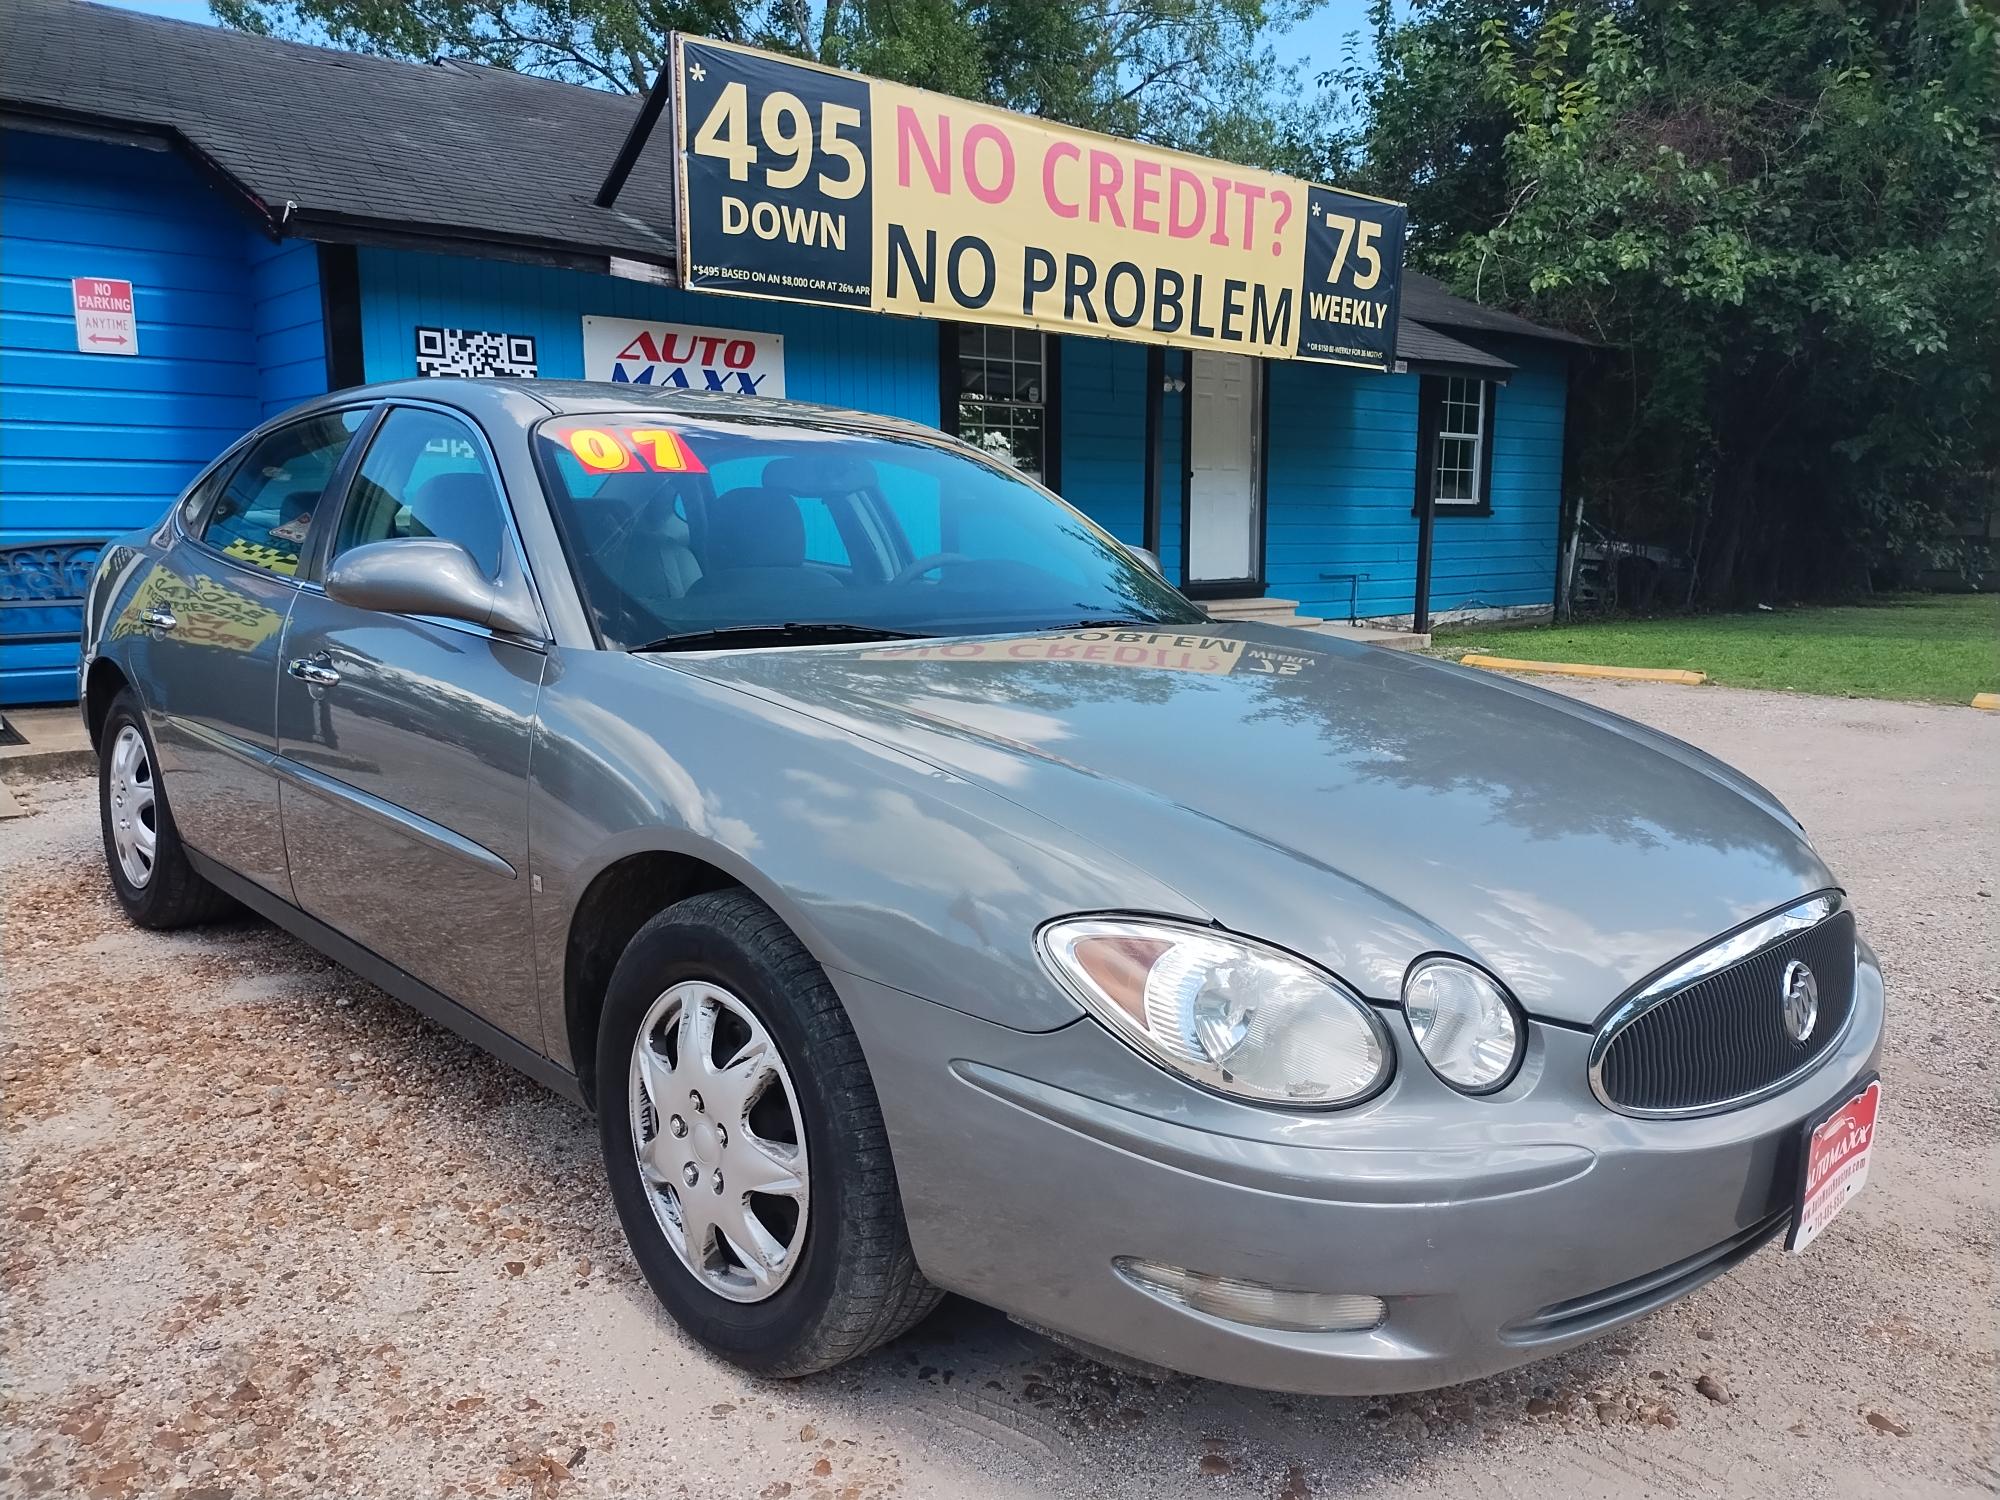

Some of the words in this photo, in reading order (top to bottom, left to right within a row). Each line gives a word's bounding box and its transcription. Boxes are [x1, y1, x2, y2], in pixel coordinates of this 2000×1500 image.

[896, 104, 1015, 204] NO
[1042, 141, 1293, 257] CREDIT?
[721, 196, 846, 251] DOWN
[93, 282, 112, 296] NO
[721, 267, 749, 280] BASED
[751, 271, 766, 283] ON
[767, 274, 780, 284] AN
[782, 275, 808, 288] $8,000
[809, 279, 826, 290] CAR
[827, 283, 837, 291] AT
[838, 282, 854, 294] 26%
[855, 285, 871, 296] APR
[886, 223, 996, 310] NO
[1022, 245, 1293, 347] PROBLEM
[78, 295, 131, 311] PARKING
[1309, 291, 1388, 329] WEEKLY
[85, 316, 129, 331] ANYTIME
[616, 331, 756, 370] AUTO
[570, 429, 688, 471] 07
